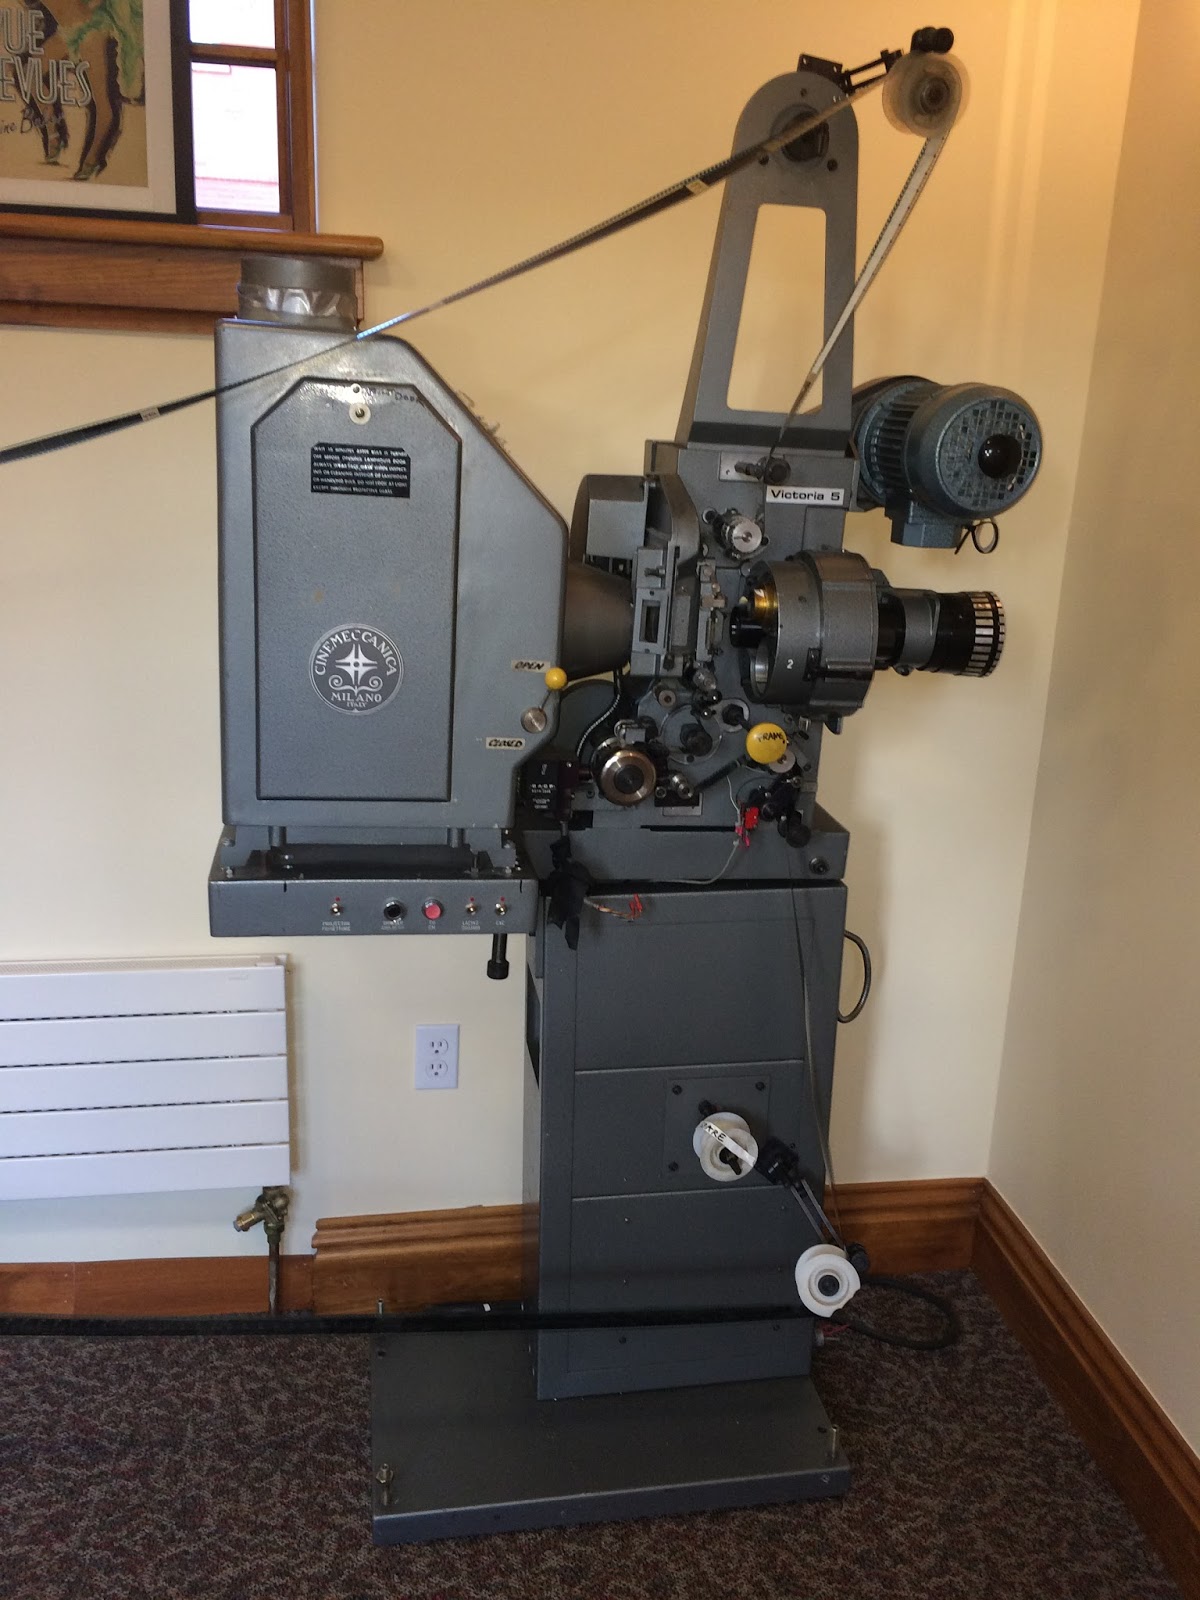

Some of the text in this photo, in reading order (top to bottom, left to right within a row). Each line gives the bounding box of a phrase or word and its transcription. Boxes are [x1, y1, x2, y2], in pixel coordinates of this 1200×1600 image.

[770, 488, 840, 501] Victoria 5
[314, 629, 397, 676] CINEMECCANICA
[514, 660, 545, 670] OPEN
[786, 659, 794, 669] 2
[331, 692, 382, 703] MILANO
